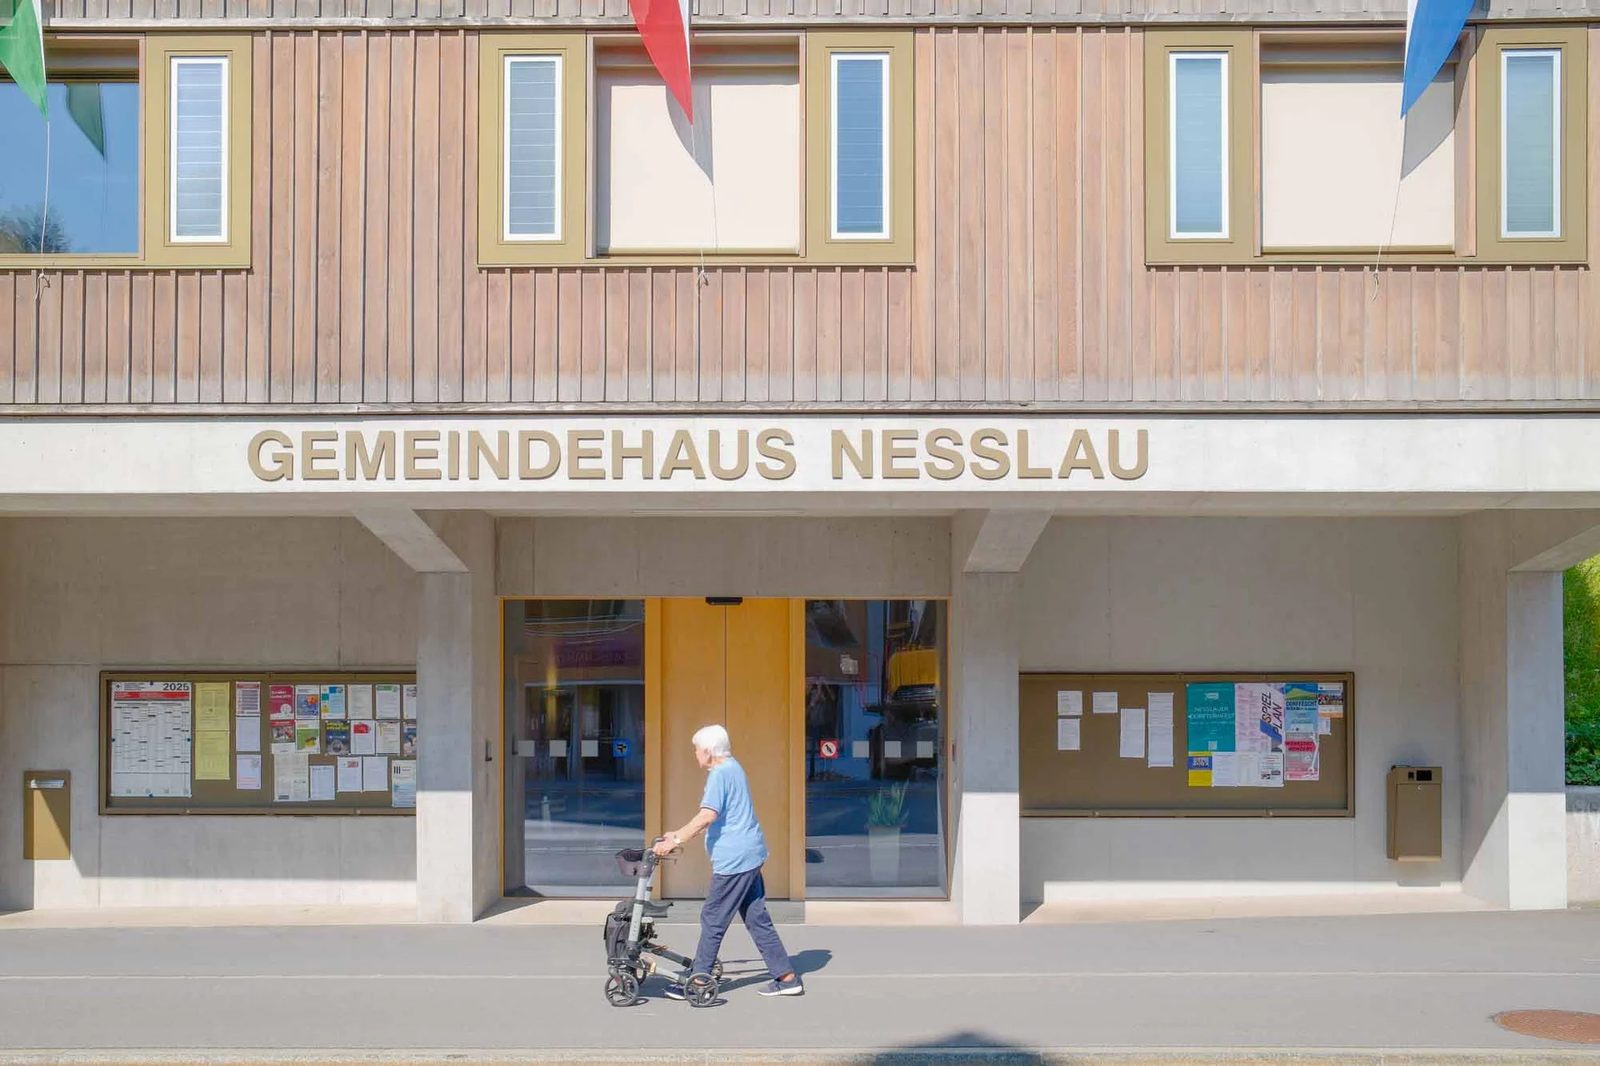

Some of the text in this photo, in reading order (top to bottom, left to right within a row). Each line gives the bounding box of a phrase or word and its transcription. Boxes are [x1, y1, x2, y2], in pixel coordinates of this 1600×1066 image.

[247, 428, 1150, 481] GEMEINDEHAUS NESSLAU
[163, 682, 190, 691] 2025
[1262, 691, 1272, 723] SPIEL
[1272, 702, 1283, 735] PLAN
